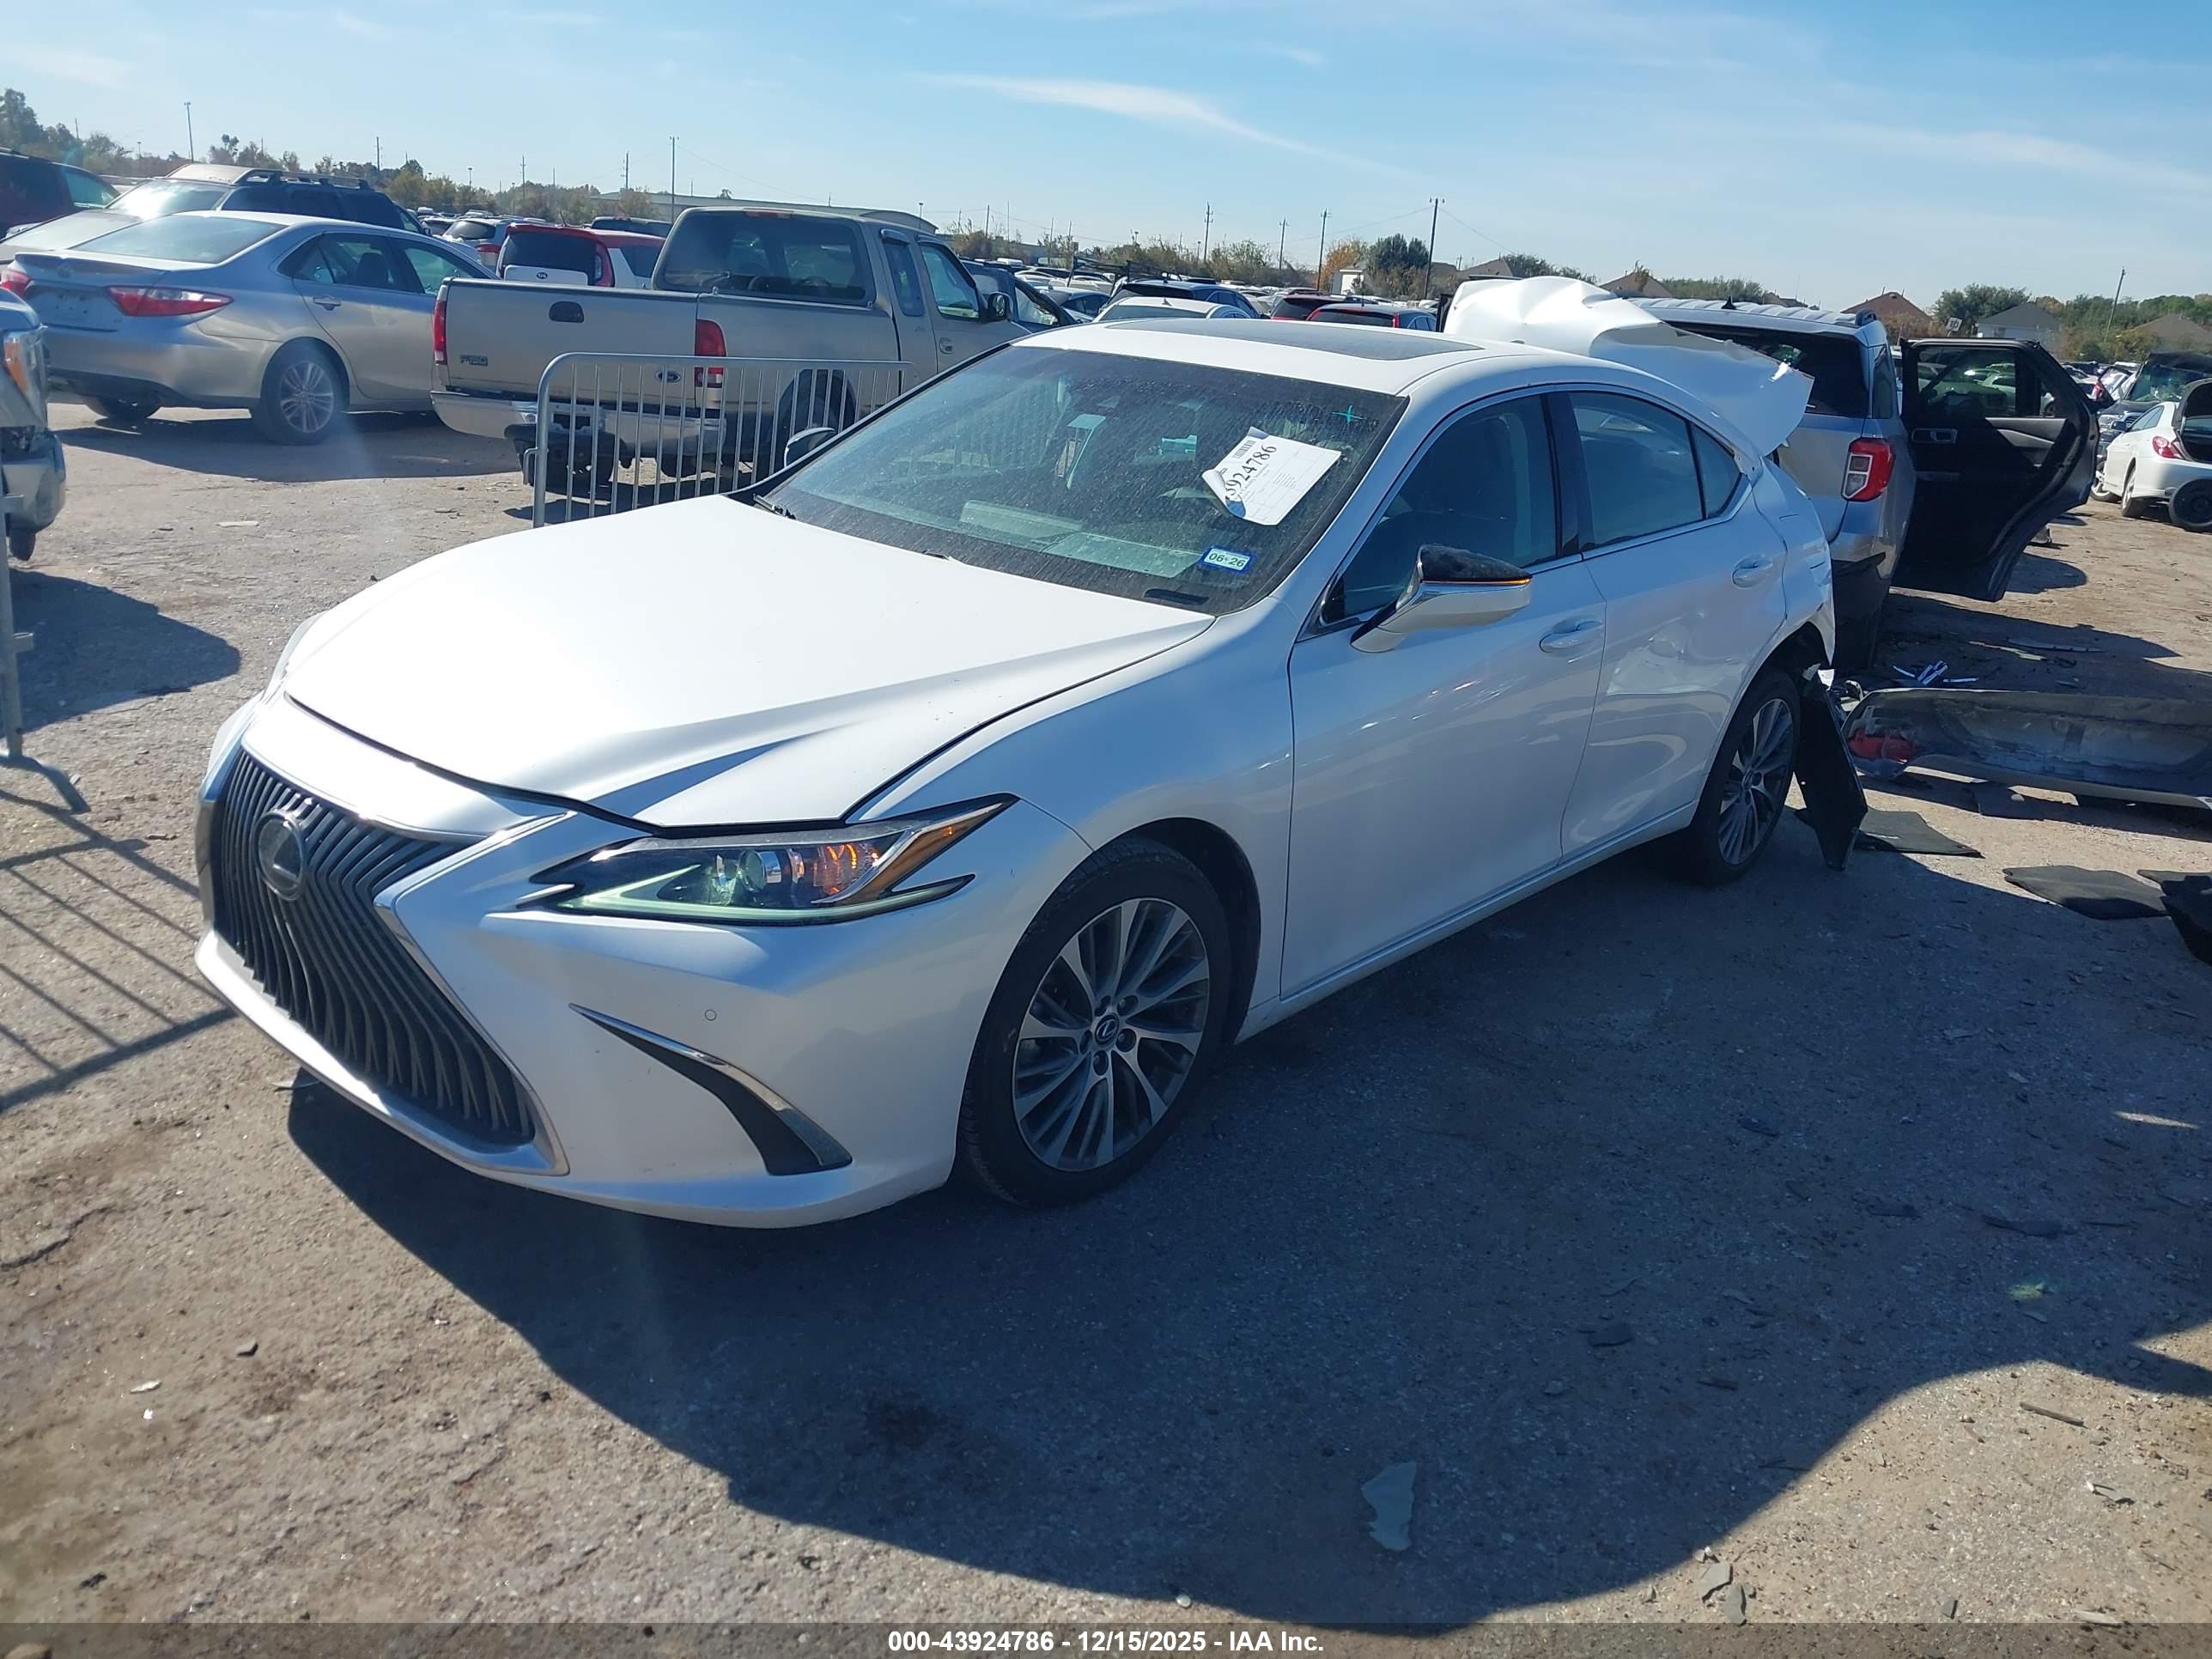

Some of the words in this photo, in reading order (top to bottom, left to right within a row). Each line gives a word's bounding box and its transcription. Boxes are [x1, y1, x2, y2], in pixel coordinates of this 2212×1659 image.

[1224, 444, 1278, 501] 3924786
[1208, 553, 1224, 562] 06
[1229, 557, 1246, 568] 26
